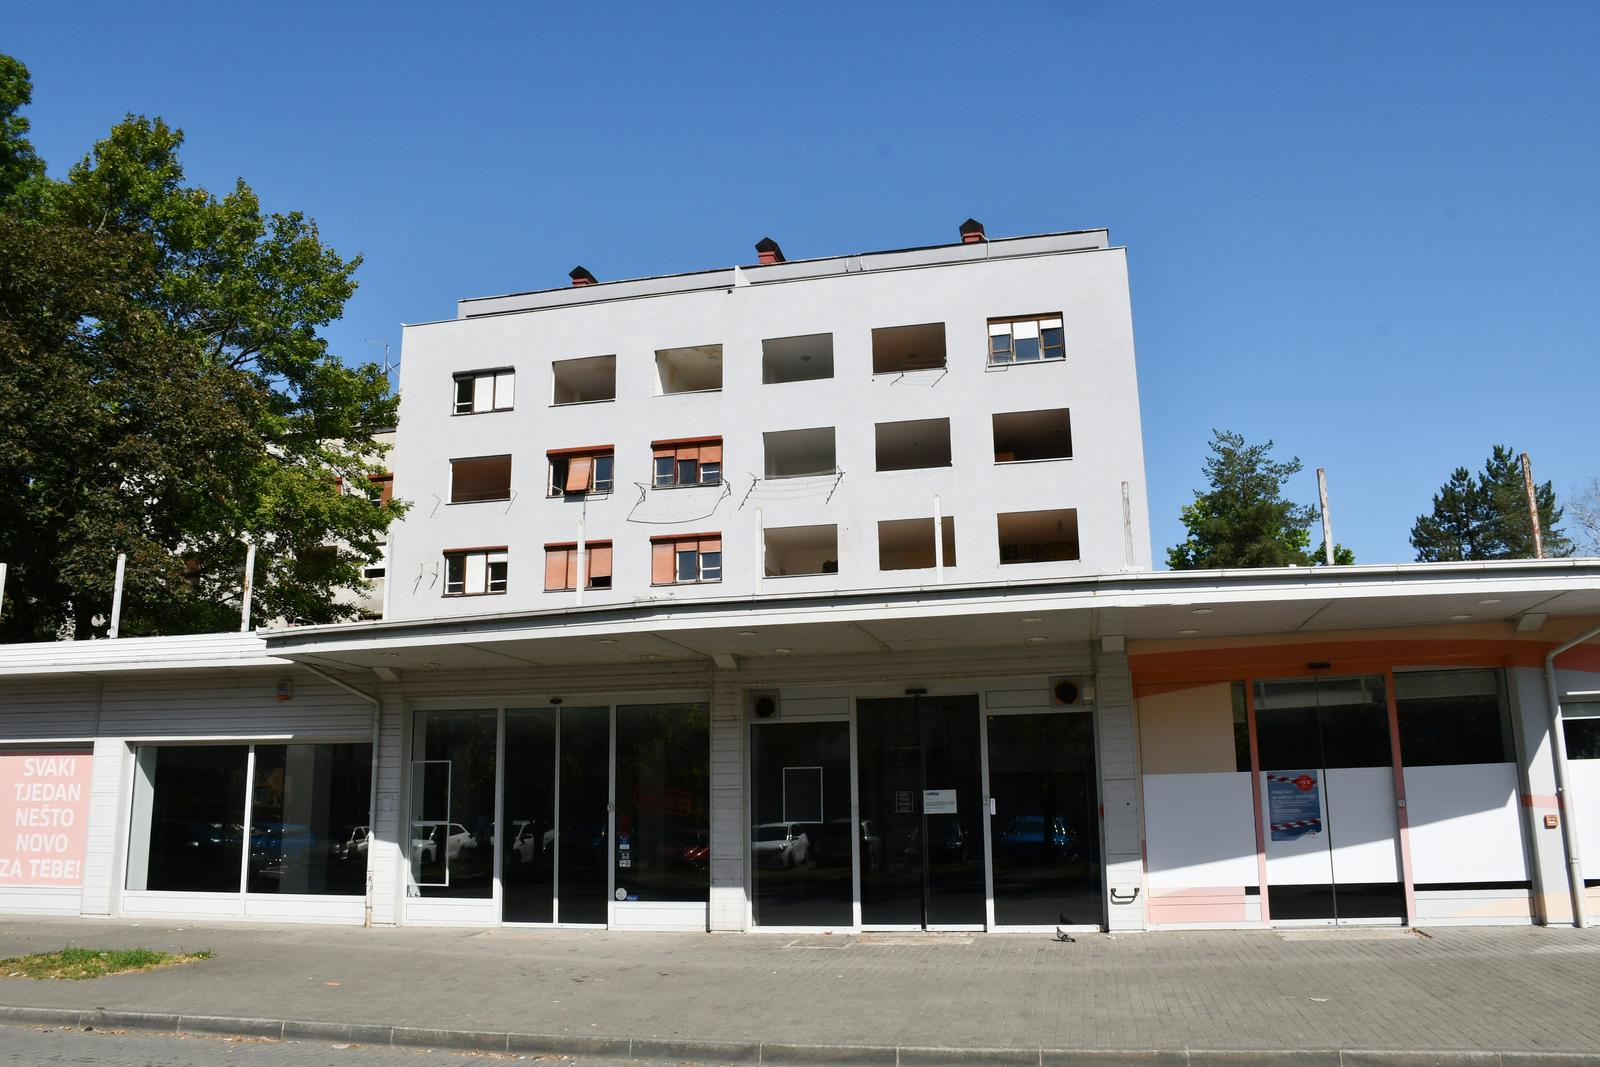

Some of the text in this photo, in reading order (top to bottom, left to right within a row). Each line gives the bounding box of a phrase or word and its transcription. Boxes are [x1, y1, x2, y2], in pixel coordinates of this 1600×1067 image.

[23, 758, 76, 777] SVAKI
[14, 783, 81, 802] TJEDAN
[15, 803, 75, 827] NEŠTO
[15, 833, 69, 853] NOVO
[0, 858, 81, 880] ZA TEBE!
